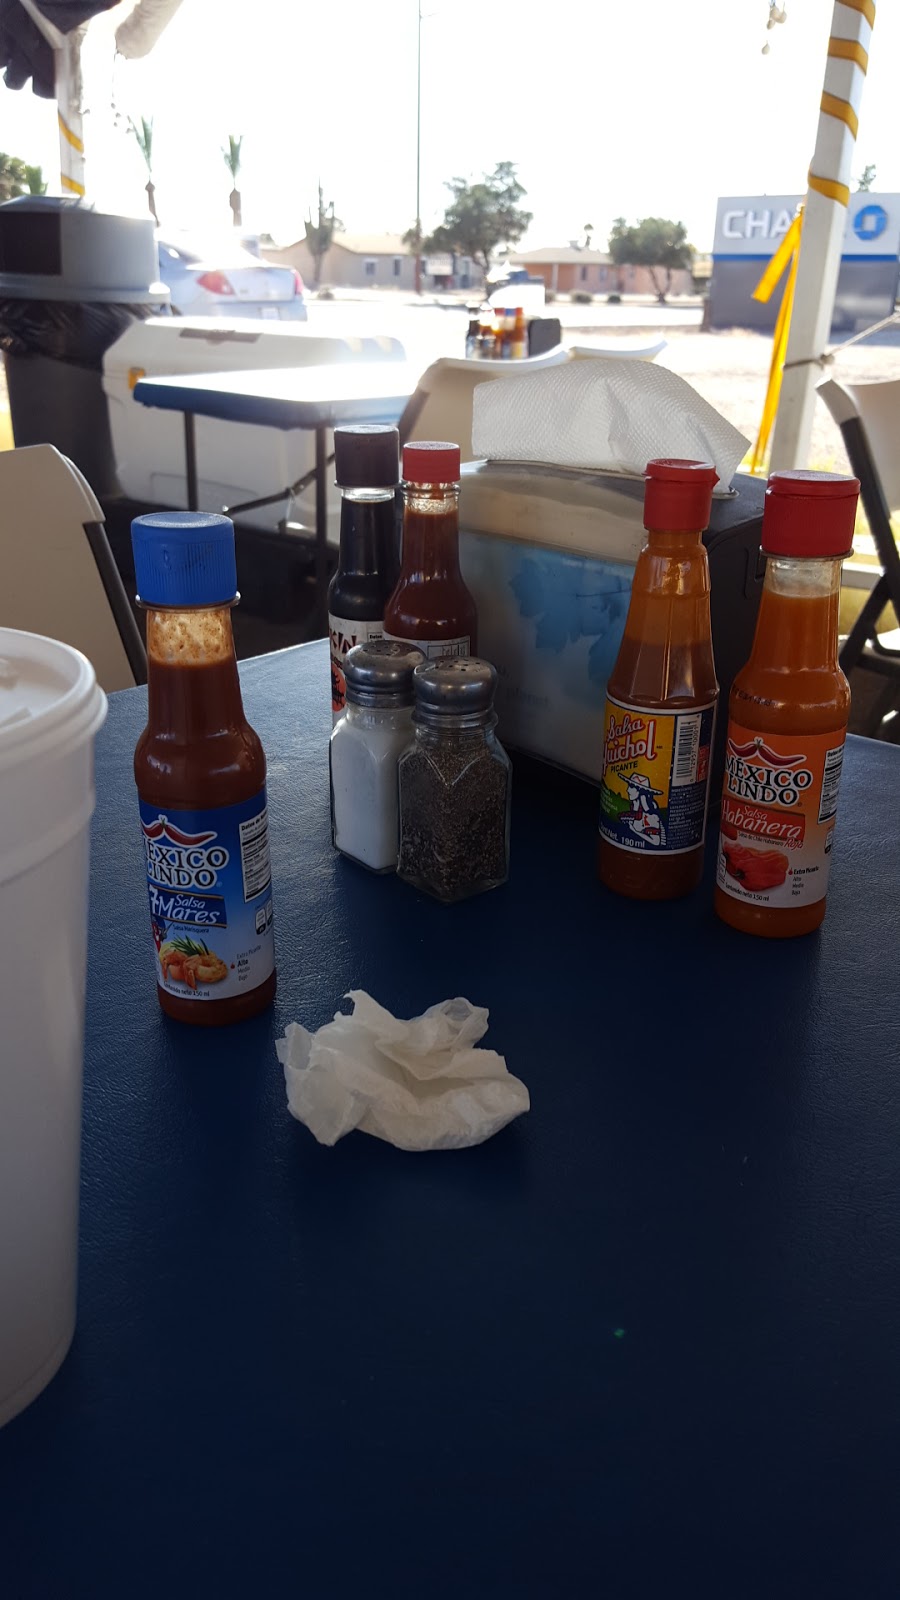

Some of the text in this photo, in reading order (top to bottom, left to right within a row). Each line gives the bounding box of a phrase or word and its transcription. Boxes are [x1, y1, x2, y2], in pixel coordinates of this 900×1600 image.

[723, 210, 796, 239] CHA
[608, 715, 645, 741] Salsa
[610, 760, 638, 772] PICANTE
[727, 757, 812, 788] MÉXICO
[729, 773, 798, 805] LINDO
[722, 799, 802, 839] Habanera
[743, 805, 768, 820] Salsa
[143, 838, 226, 868] ÉXICO
[621, 836, 634, 847] 190
[635, 840, 645, 849] ml
[158, 895, 221, 924] Mares
[174, 893, 206, 910] Salsa
[237, 959, 248, 967] Alto
